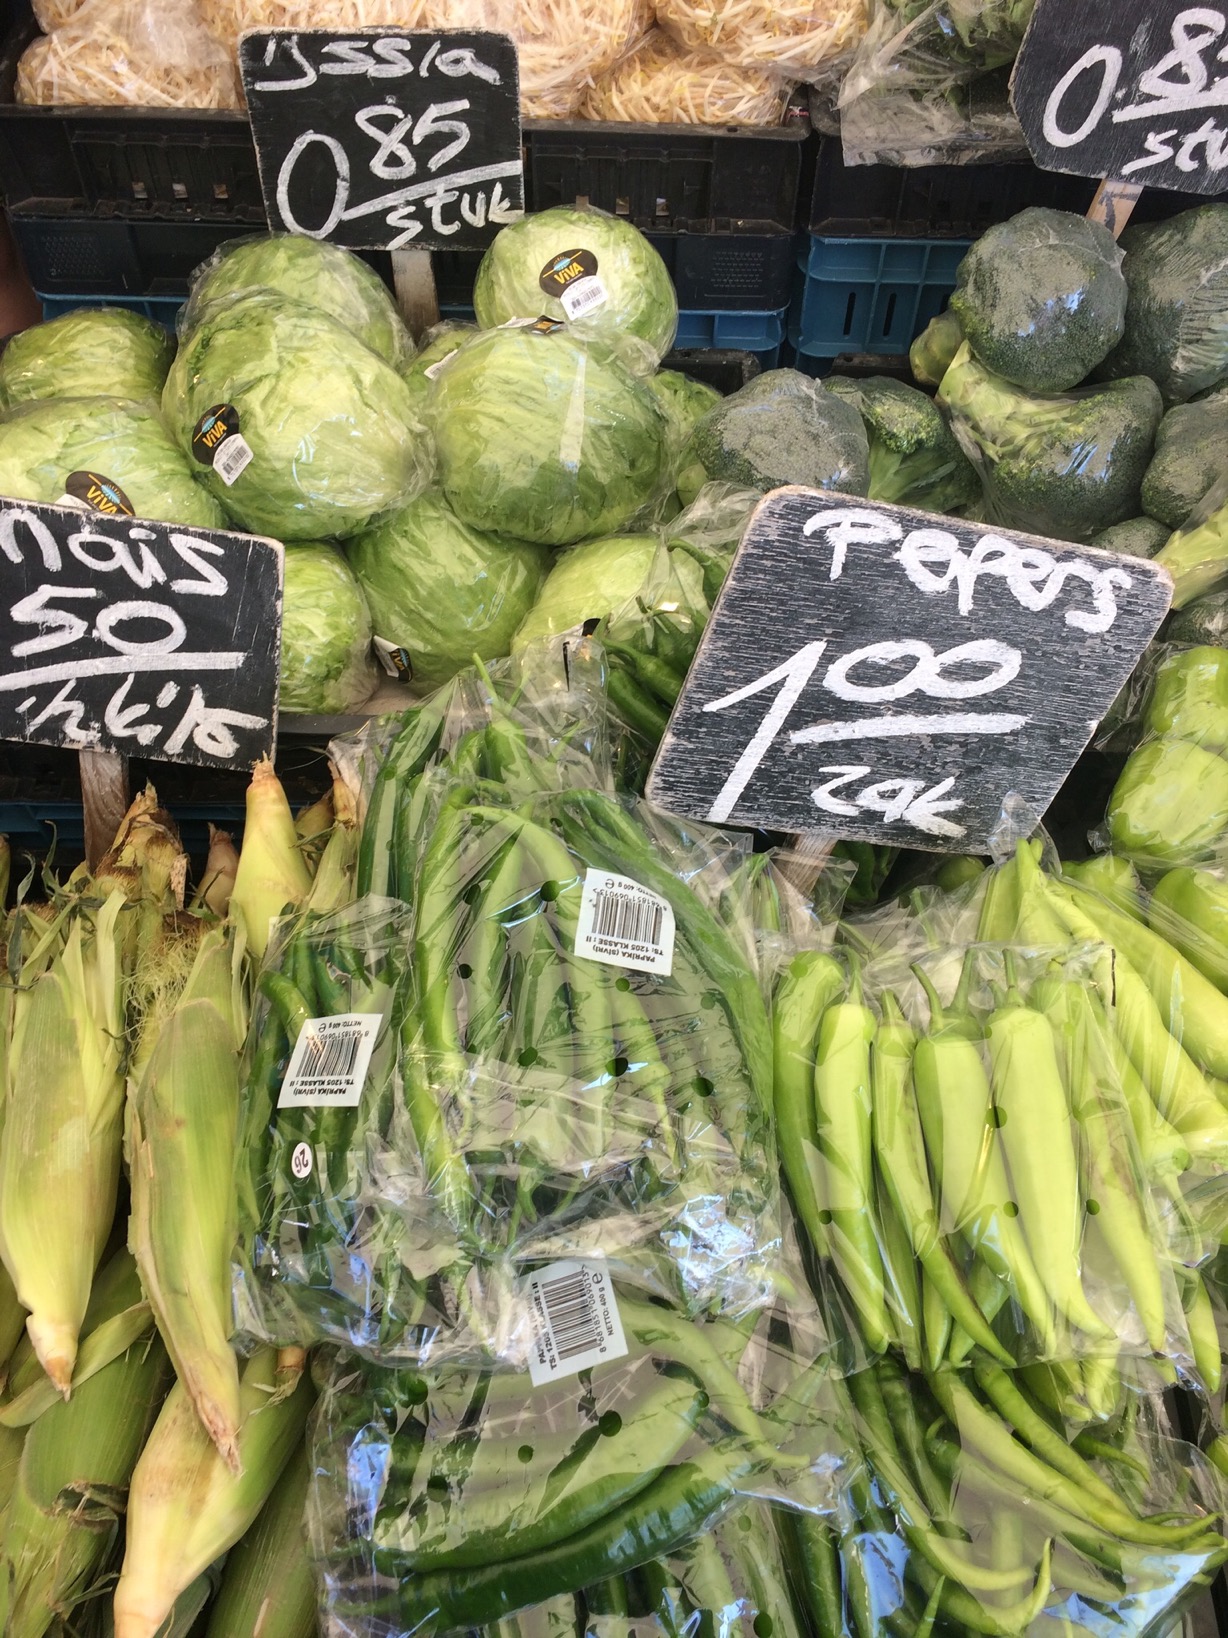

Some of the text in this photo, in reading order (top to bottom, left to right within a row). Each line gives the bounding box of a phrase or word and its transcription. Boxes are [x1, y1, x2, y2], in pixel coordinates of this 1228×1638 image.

[1043, 7, 1228, 148] 0.8
[1121, 116, 1228, 176] stu
[385, 181, 525, 250] stuk
[811, 765, 968, 838] zak
[598, 938, 629, 950] KLASSE
[299, 1080, 325, 1088] KLASSE
[294, 1147, 309, 1174] 26
[599, 1293, 607, 1306] 400
[602, 1307, 614, 1336] NETTO:
